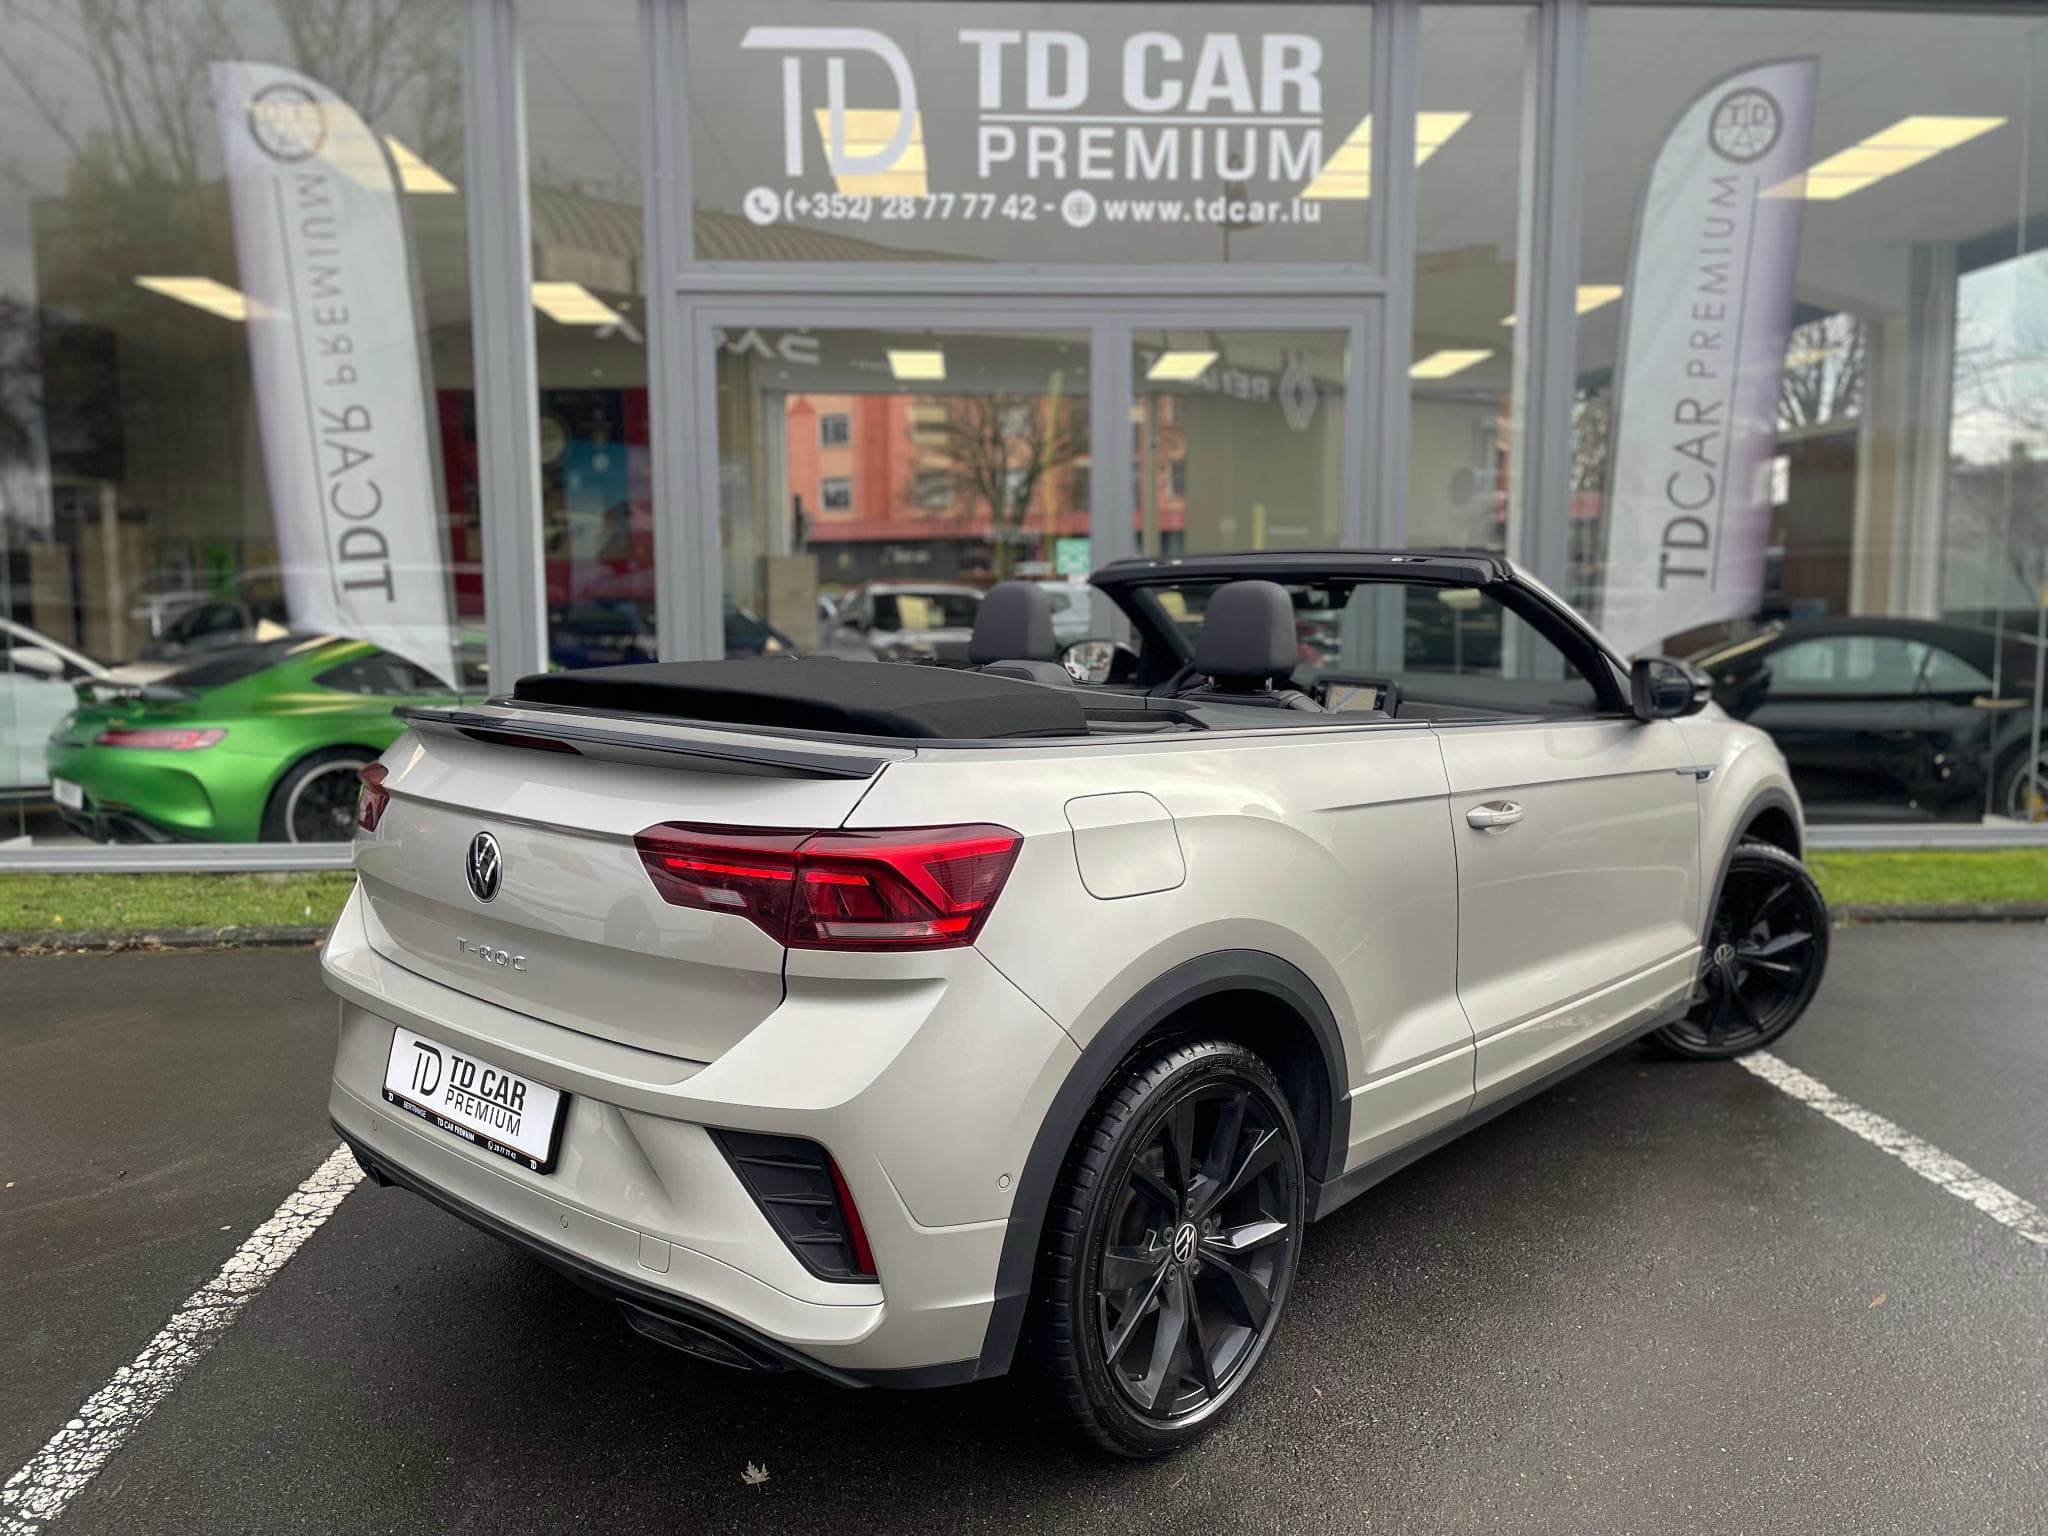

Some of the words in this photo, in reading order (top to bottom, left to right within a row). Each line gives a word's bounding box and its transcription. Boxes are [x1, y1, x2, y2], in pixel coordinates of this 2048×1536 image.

[958, 29, 1089, 110] TD
[1122, 31, 1323, 113] CAR
[978, 125, 1323, 181] PREMIUM
[783, 189, 872, 222] (+352)
[881, 194, 917, 220] 28
[923, 194, 955, 220] 77
[962, 194, 996, 221] 77
[1001, 194, 1037, 221] 42
[1103, 196, 1322, 223] www.tdcar.lu
[1686, 174, 1740, 381] PREMIUM
[456, 936, 528, 973] T-ROC
[449, 1055, 476, 1089] TD
[480, 1069, 527, 1112] CAR
[444, 1088, 521, 1137] PREMIUM
